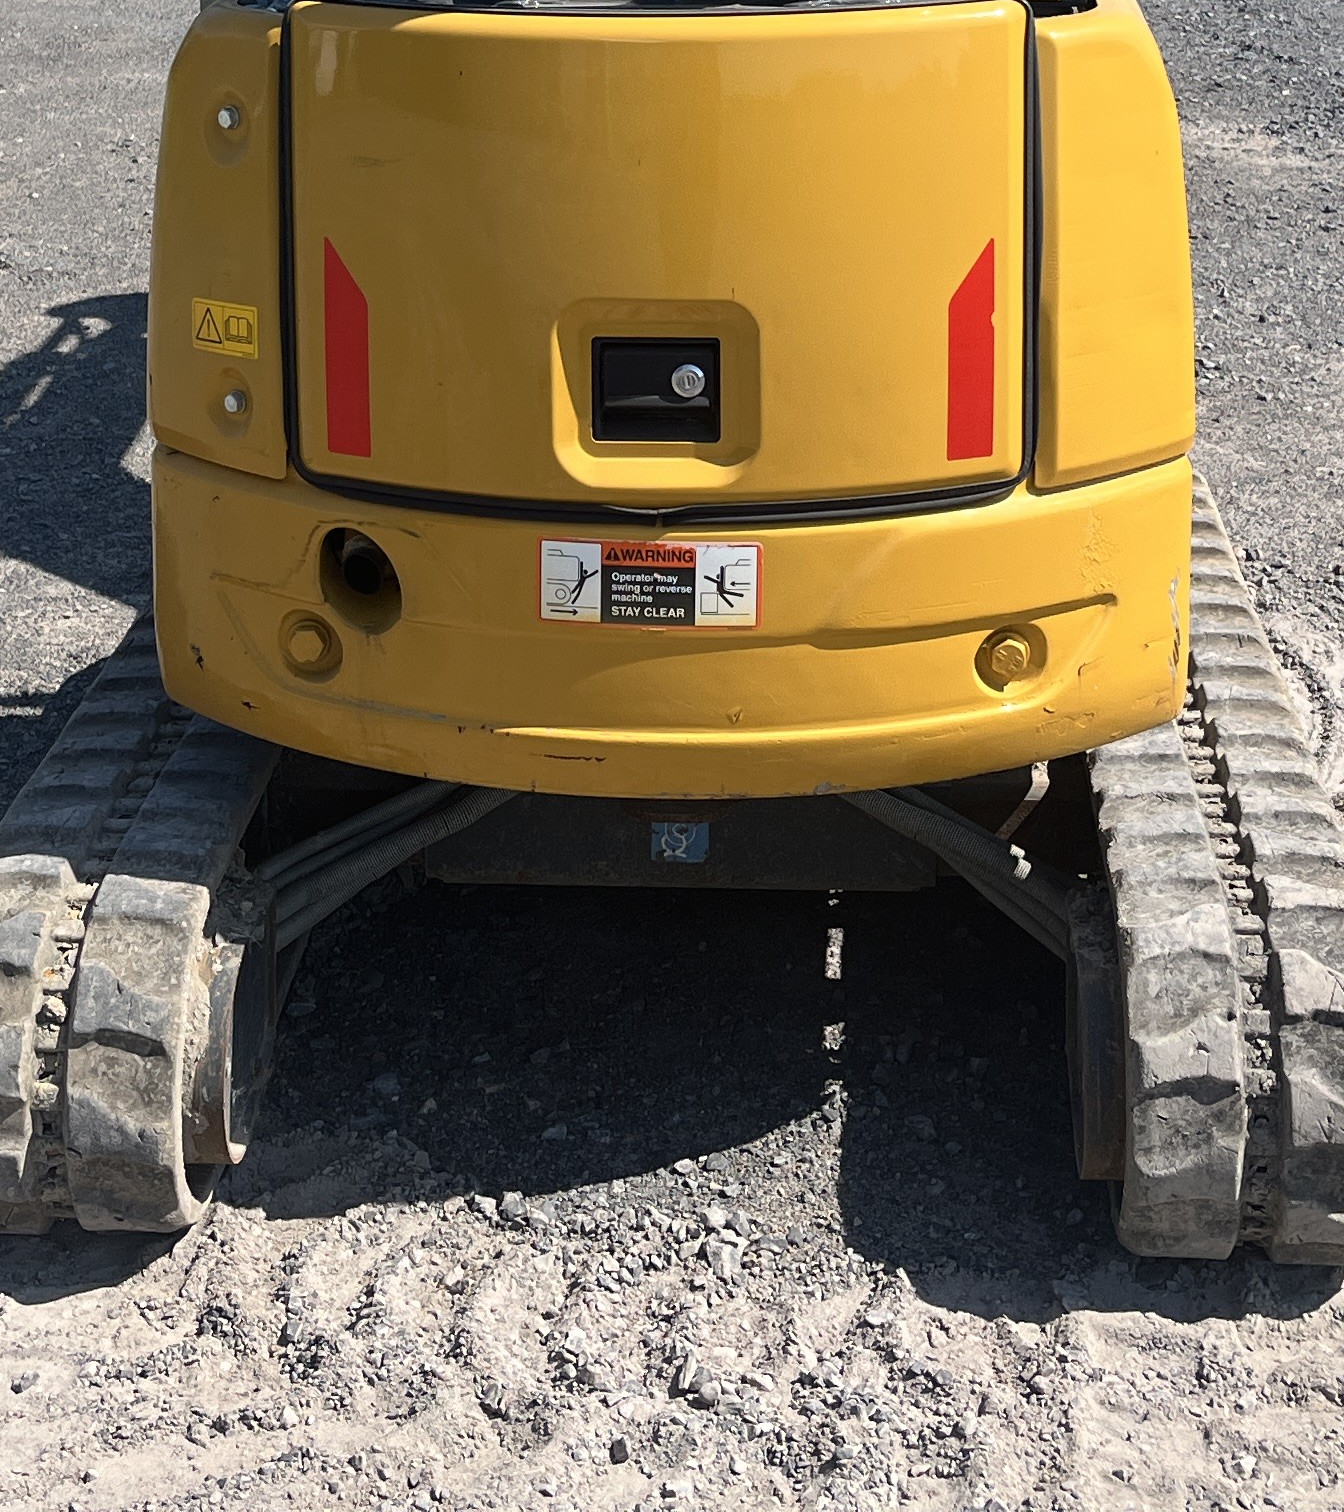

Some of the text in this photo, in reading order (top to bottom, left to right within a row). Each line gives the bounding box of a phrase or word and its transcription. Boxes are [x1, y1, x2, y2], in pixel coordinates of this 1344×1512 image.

[620, 549, 694, 563] WARNING
[611, 572, 678, 584] Operator may
[611, 583, 640, 593] swing
[611, 593, 653, 603] machine
[611, 606, 685, 618] STAY CLEAR
